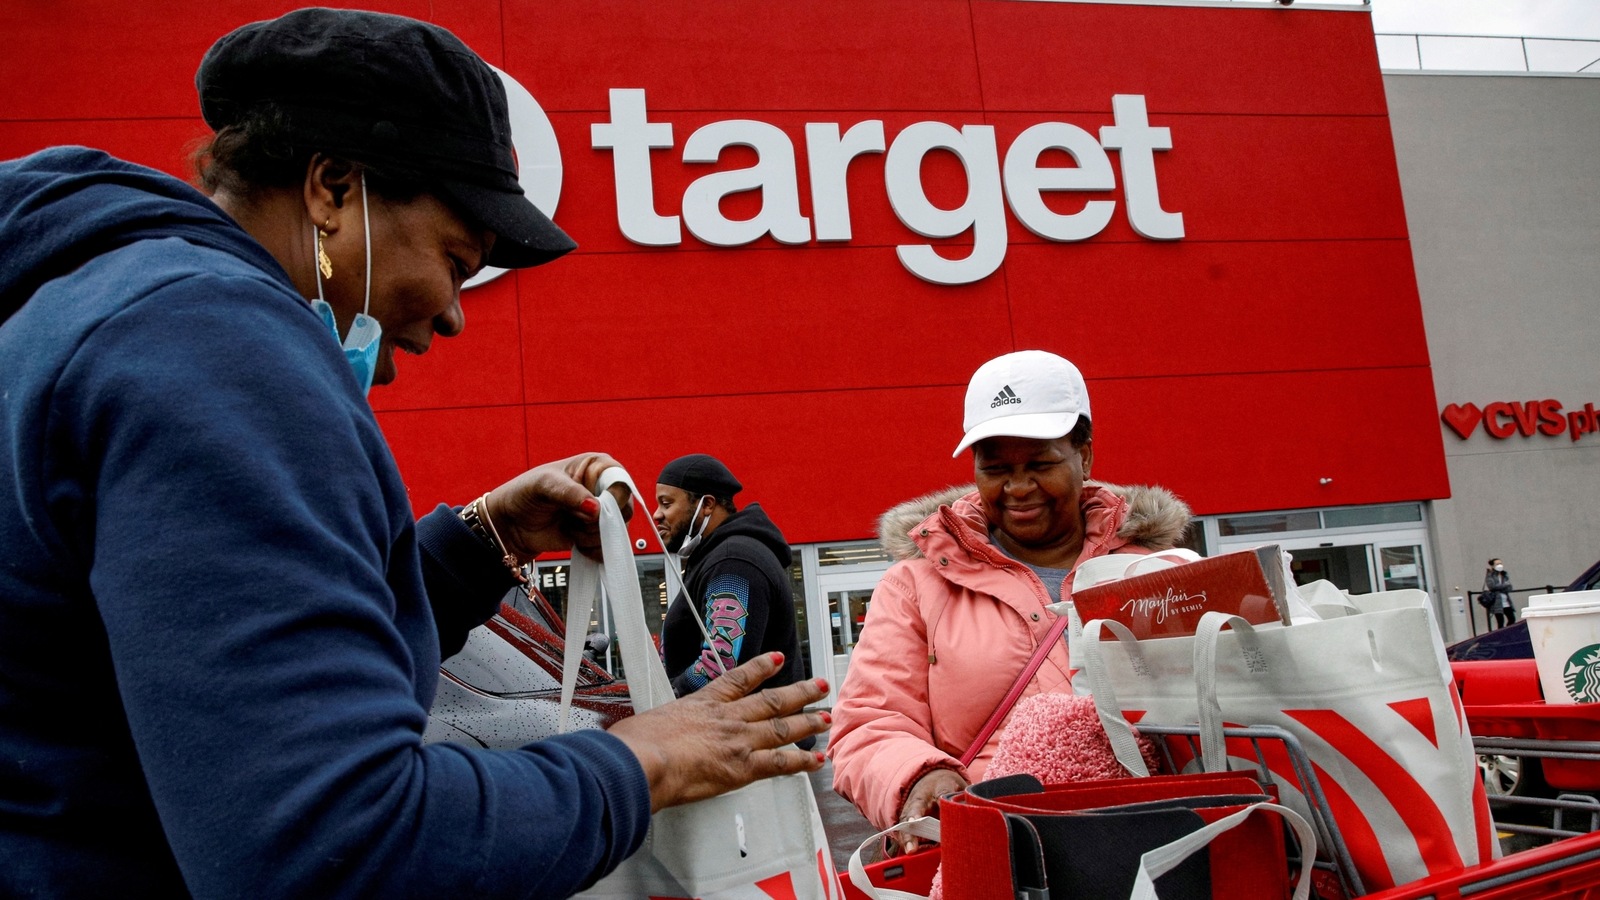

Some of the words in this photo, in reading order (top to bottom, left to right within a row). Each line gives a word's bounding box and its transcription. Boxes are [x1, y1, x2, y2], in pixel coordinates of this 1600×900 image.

[590, 88, 1185, 285] target
[990, 396, 1022, 409] adidas
[1482, 399, 1566, 439] CVS
[1120, 587, 1206, 625] Mayfair
[1181, 603, 1203, 613] BEMIS
